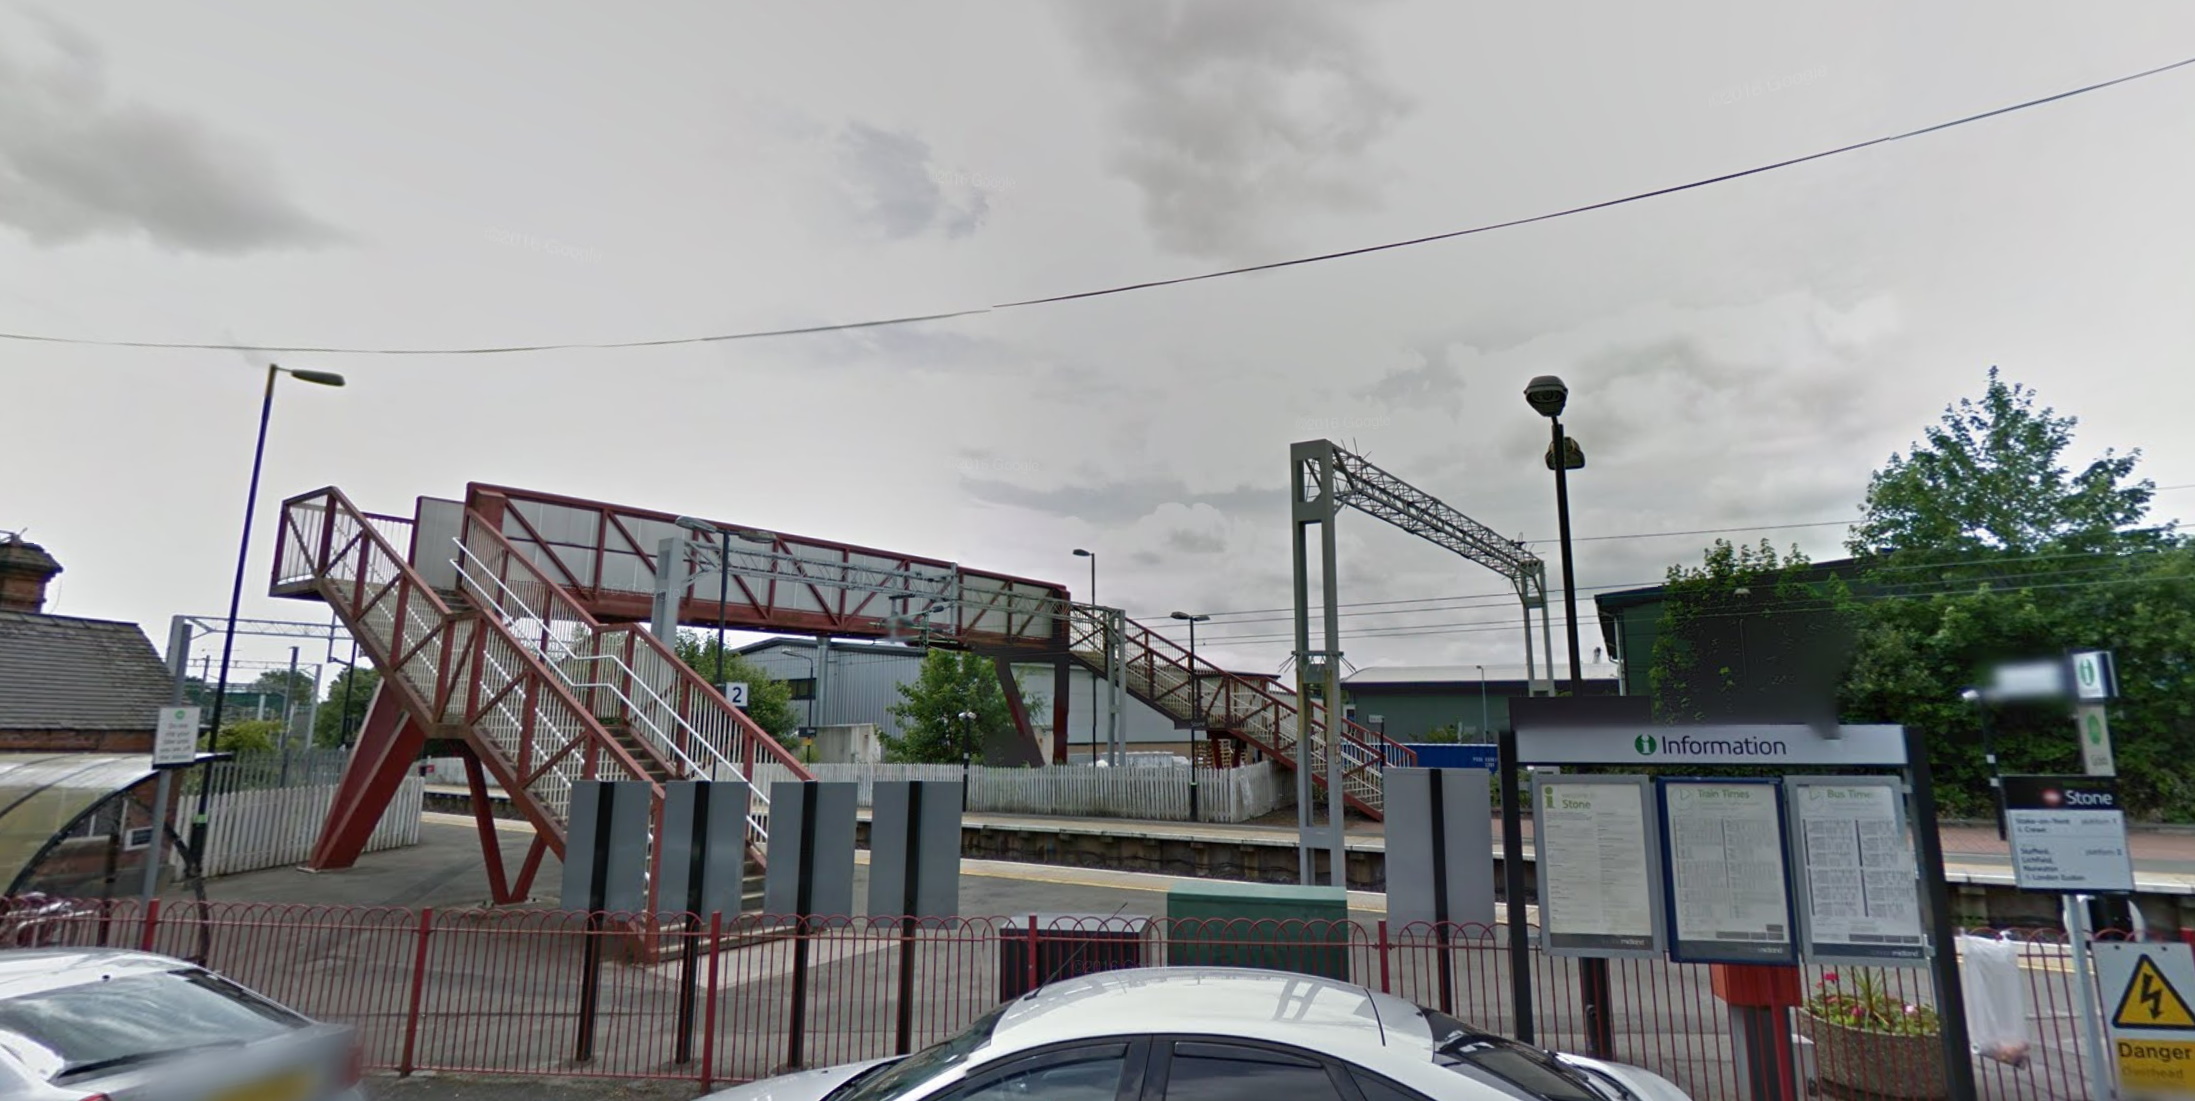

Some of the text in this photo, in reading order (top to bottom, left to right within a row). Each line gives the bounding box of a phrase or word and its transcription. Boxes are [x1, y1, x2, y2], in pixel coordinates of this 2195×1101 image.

[732, 686, 742, 703] 2
[1662, 735, 1787, 755] Information
[1697, 789, 1750, 799] Train Times
[1827, 789, 1874, 799] Bus Time
[2065, 789, 2113, 806] Stone
[1562, 799, 1591, 809] Stone
[2117, 1042, 2193, 1063] Danger
